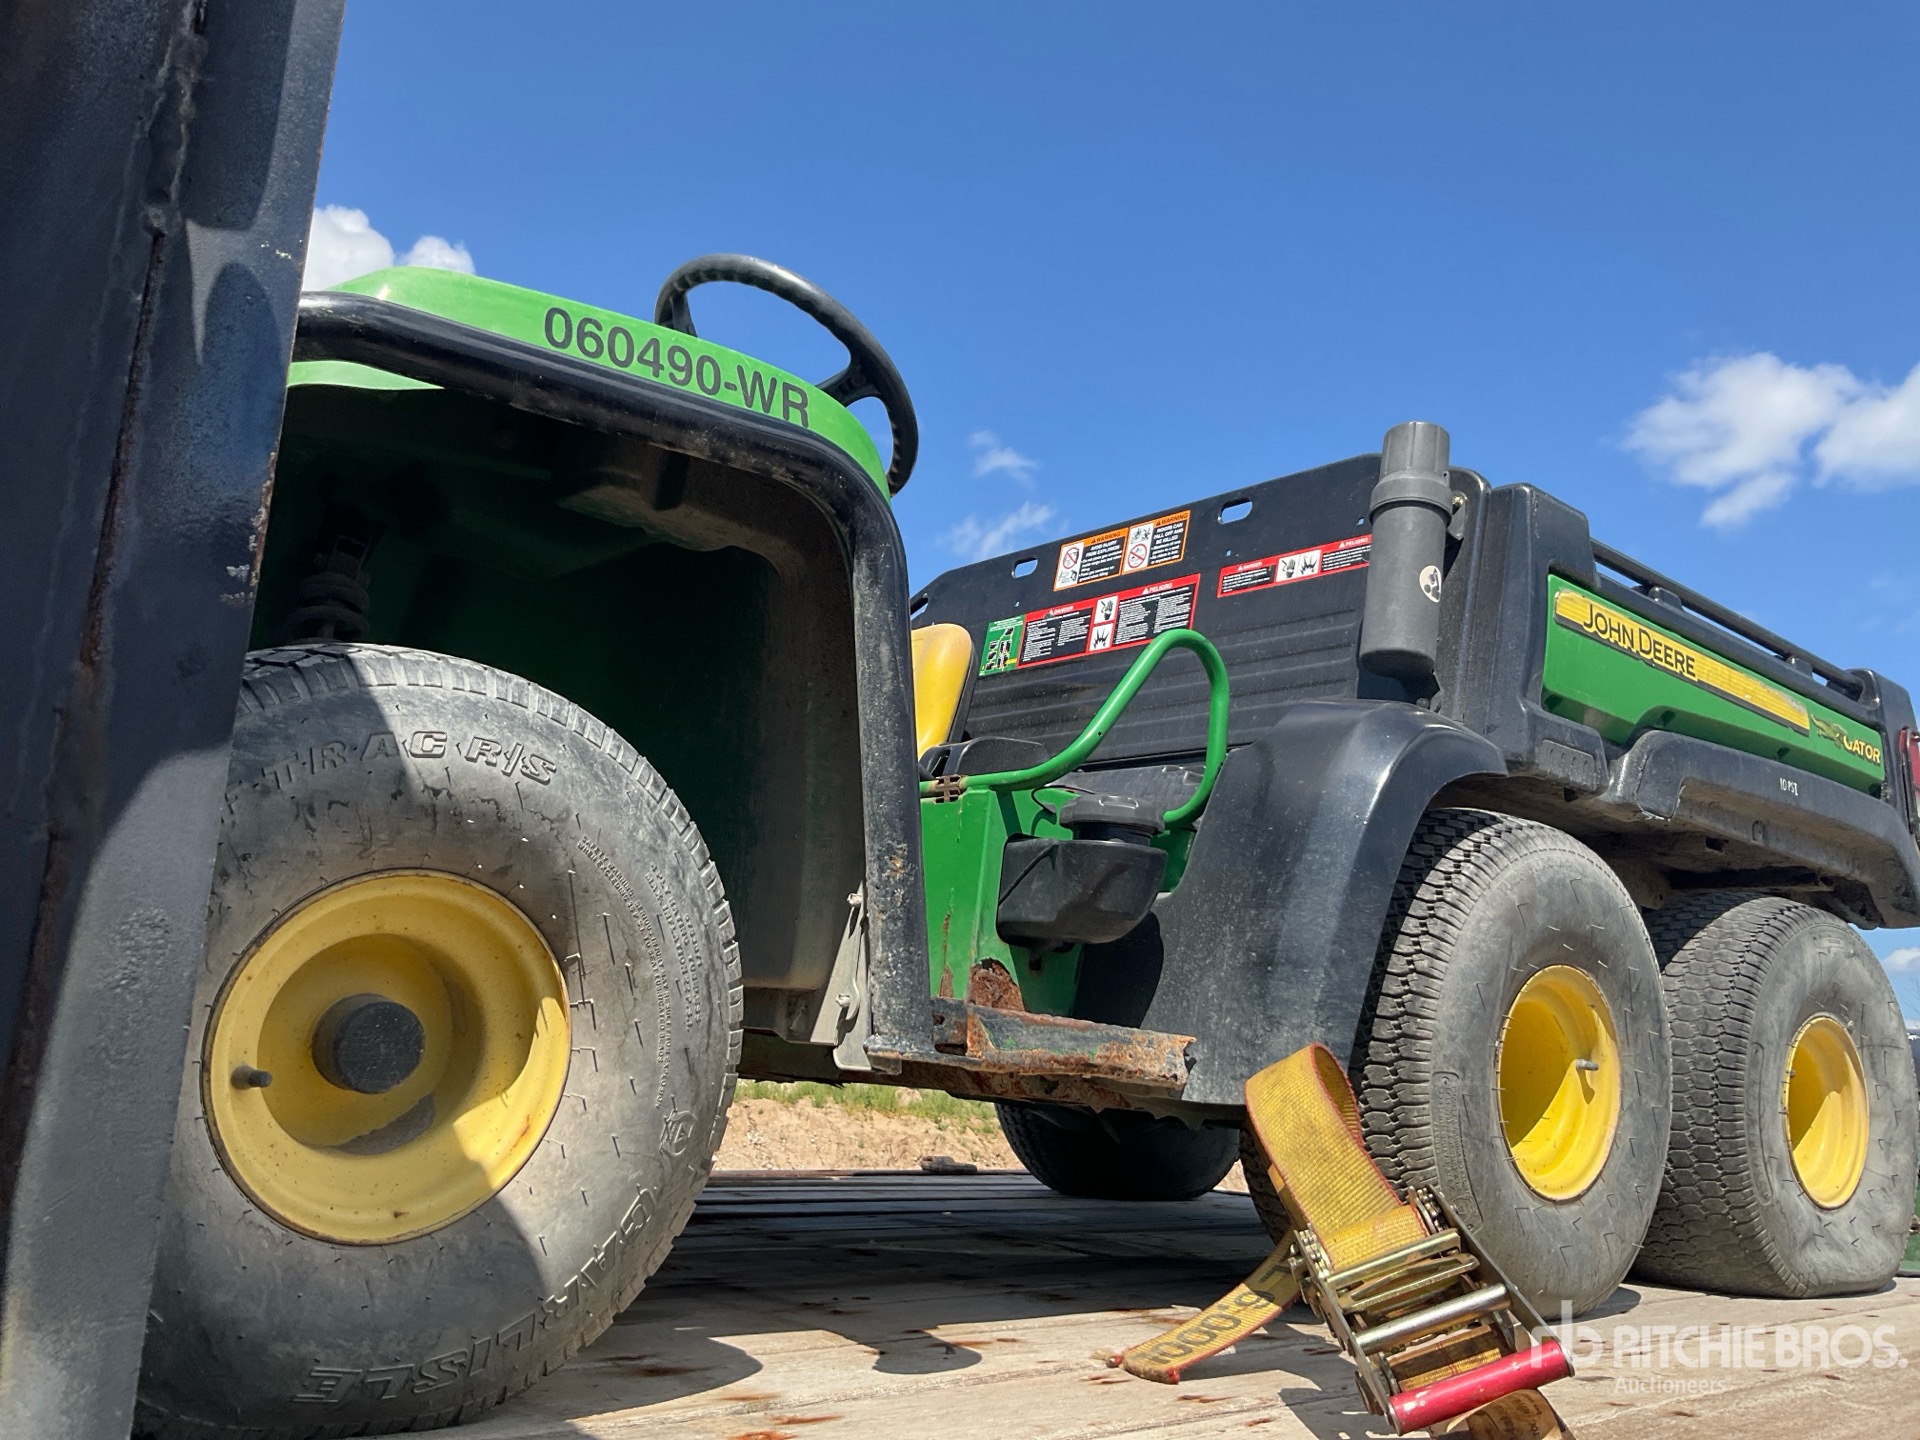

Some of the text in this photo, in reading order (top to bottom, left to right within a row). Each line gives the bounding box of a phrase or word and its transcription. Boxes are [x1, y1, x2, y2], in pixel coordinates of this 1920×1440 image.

[544, 306, 809, 428] 060490-WR
[1149, 582, 1173, 592] PELIGRO
[1583, 604, 1697, 678] JOHN DEERE
[464, 735, 558, 785] R/S
[1843, 735, 1881, 764] GATOR
[1779, 777, 1799, 796] 10 PSI
[293, 1186, 659, 1403] CARLISLE
